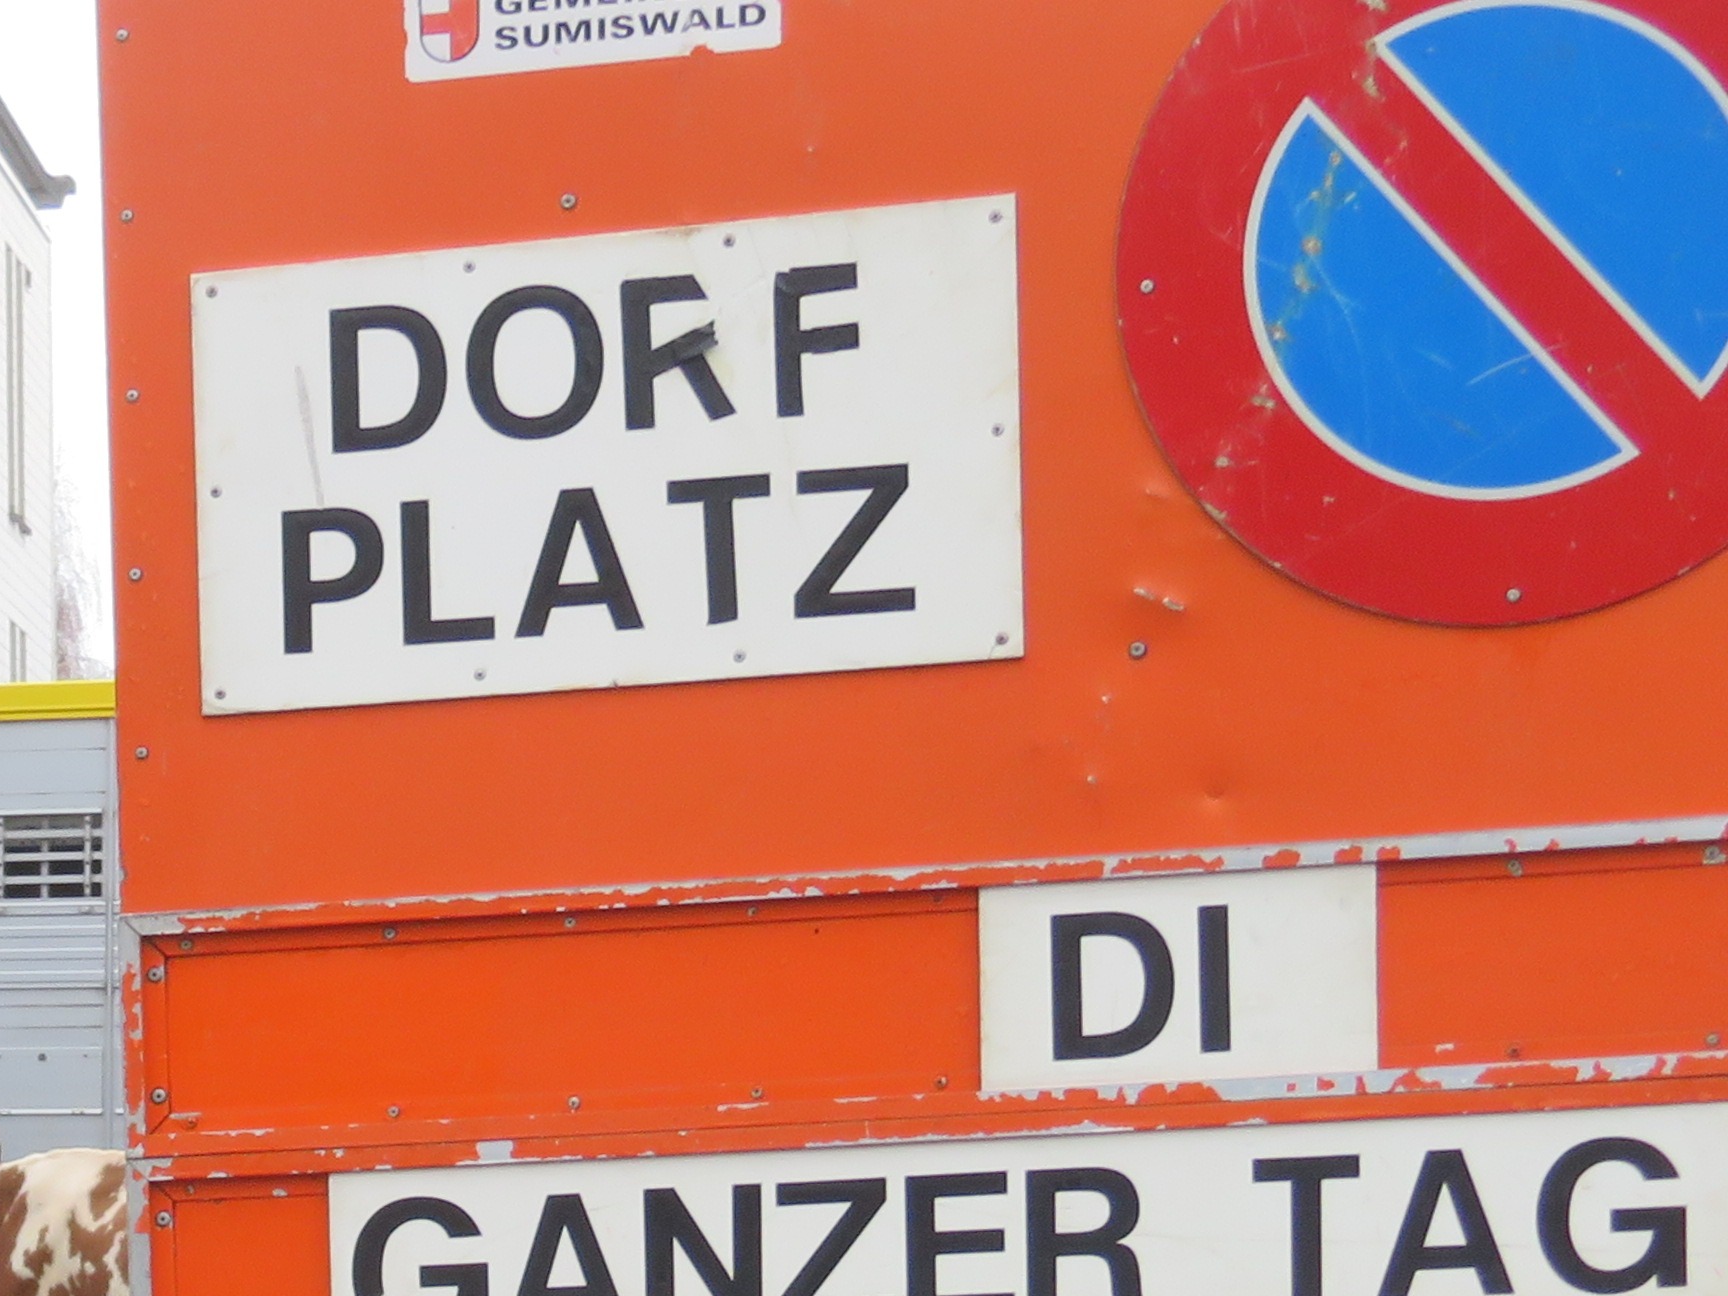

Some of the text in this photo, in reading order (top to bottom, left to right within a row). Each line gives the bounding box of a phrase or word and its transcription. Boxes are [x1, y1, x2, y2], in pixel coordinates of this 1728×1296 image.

[495, 3, 767, 50] SUMISWALD
[328, 261, 862, 455] DORF
[281, 462, 918, 656] PLATZ
[1049, 903, 1233, 1063] DI
